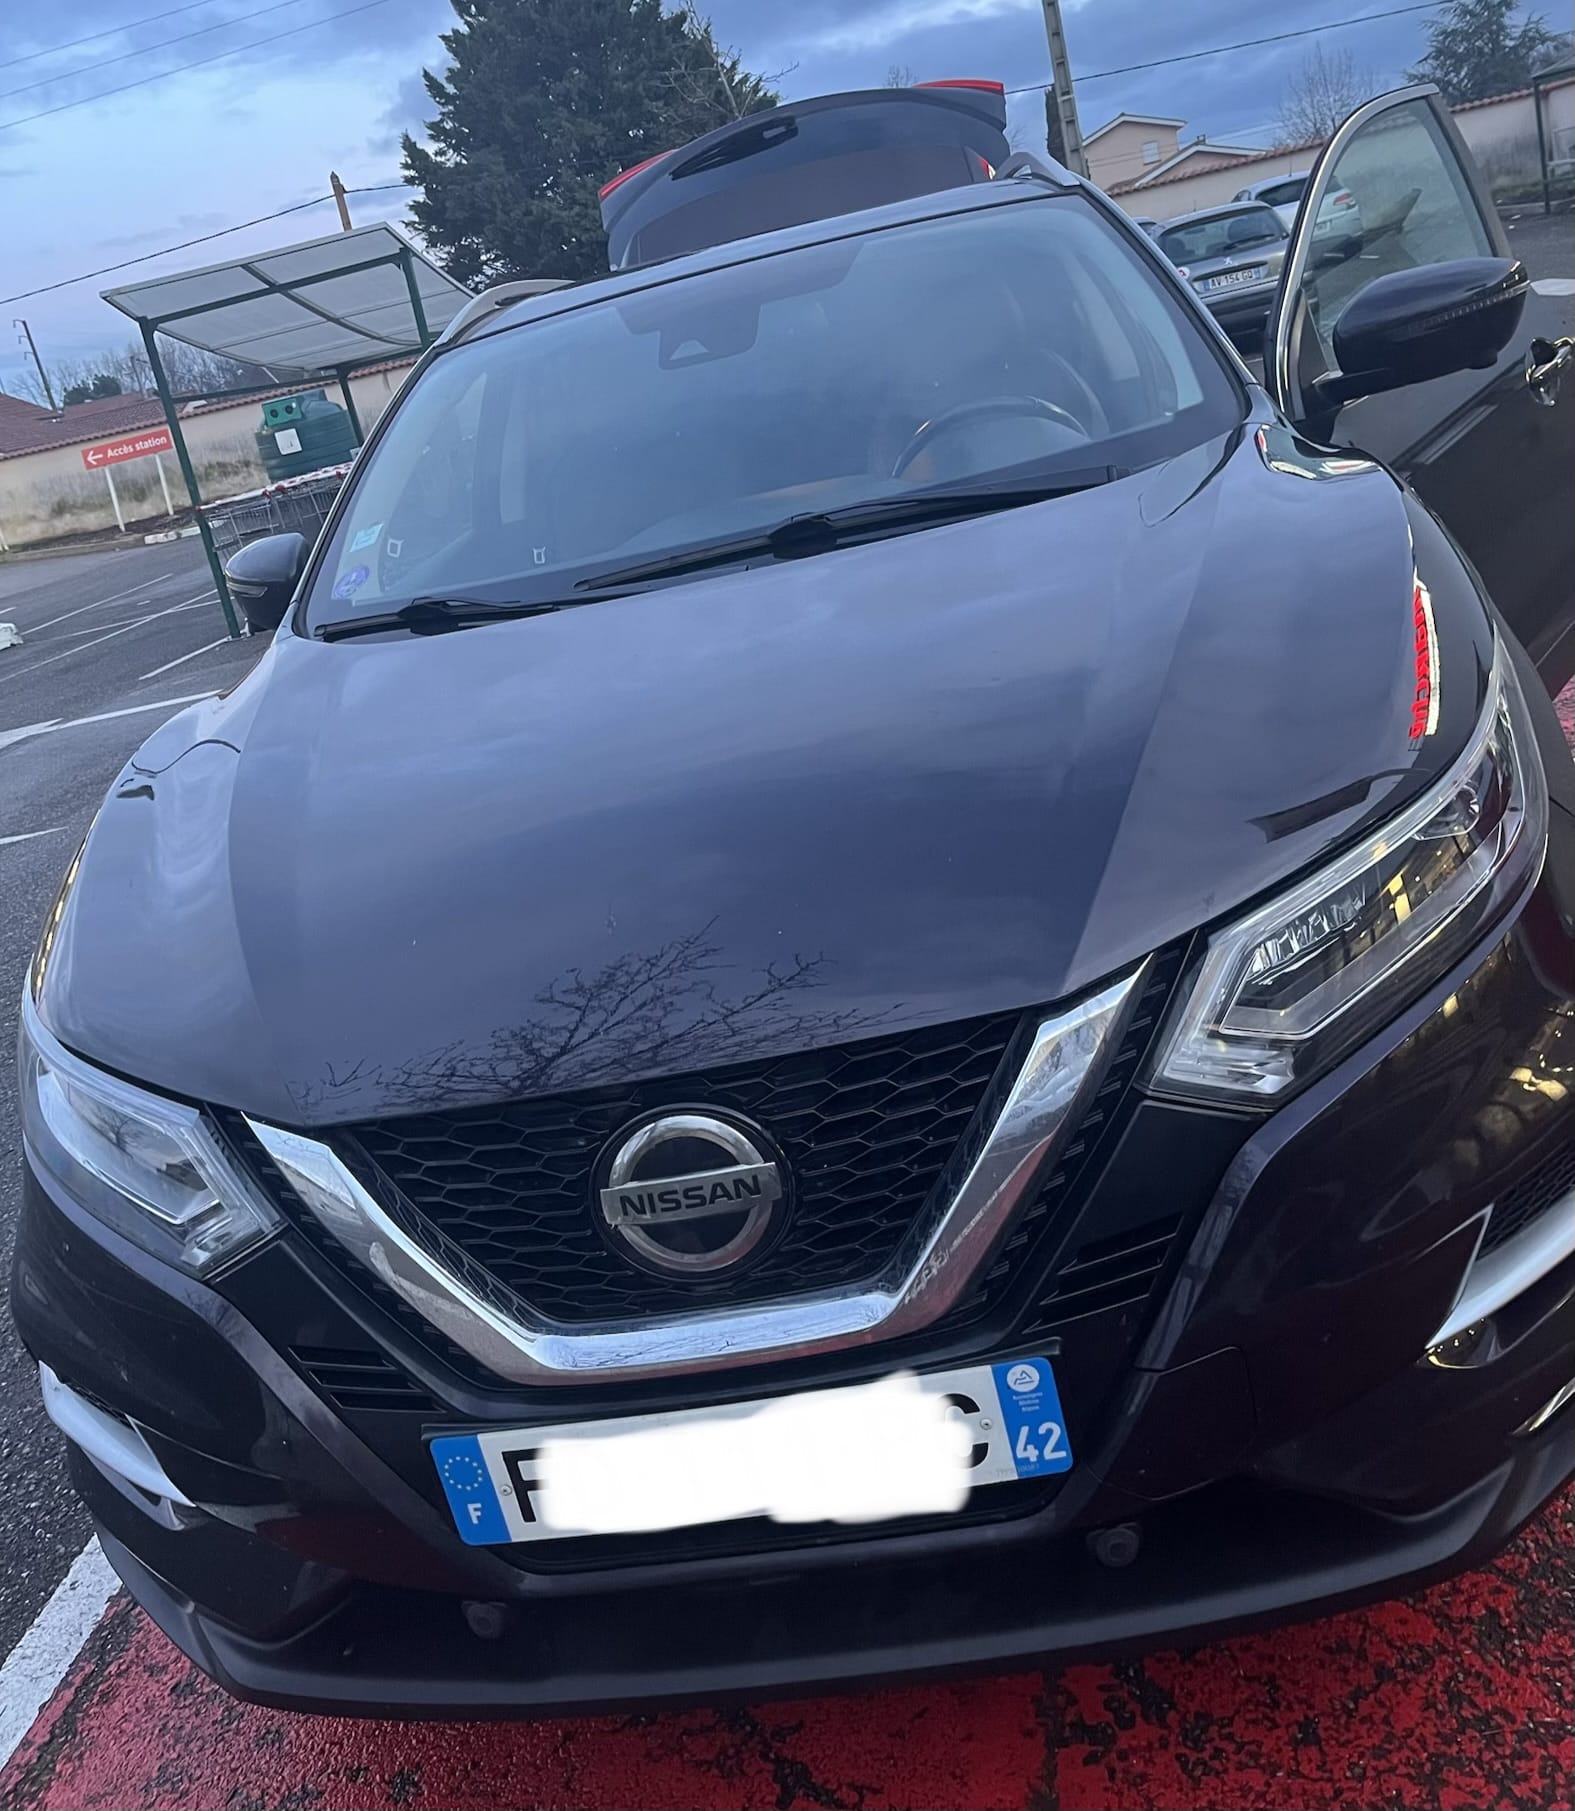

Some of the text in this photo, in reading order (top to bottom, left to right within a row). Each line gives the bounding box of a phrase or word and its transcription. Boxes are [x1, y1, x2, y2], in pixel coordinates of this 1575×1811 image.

[1223, 272, 1241, 284] 154
[107, 436, 168, 459] Accès station
[619, 1174, 762, 1217] NISSAN
[1015, 1421, 1068, 1463] 42
[466, 1502, 483, 1525] F
